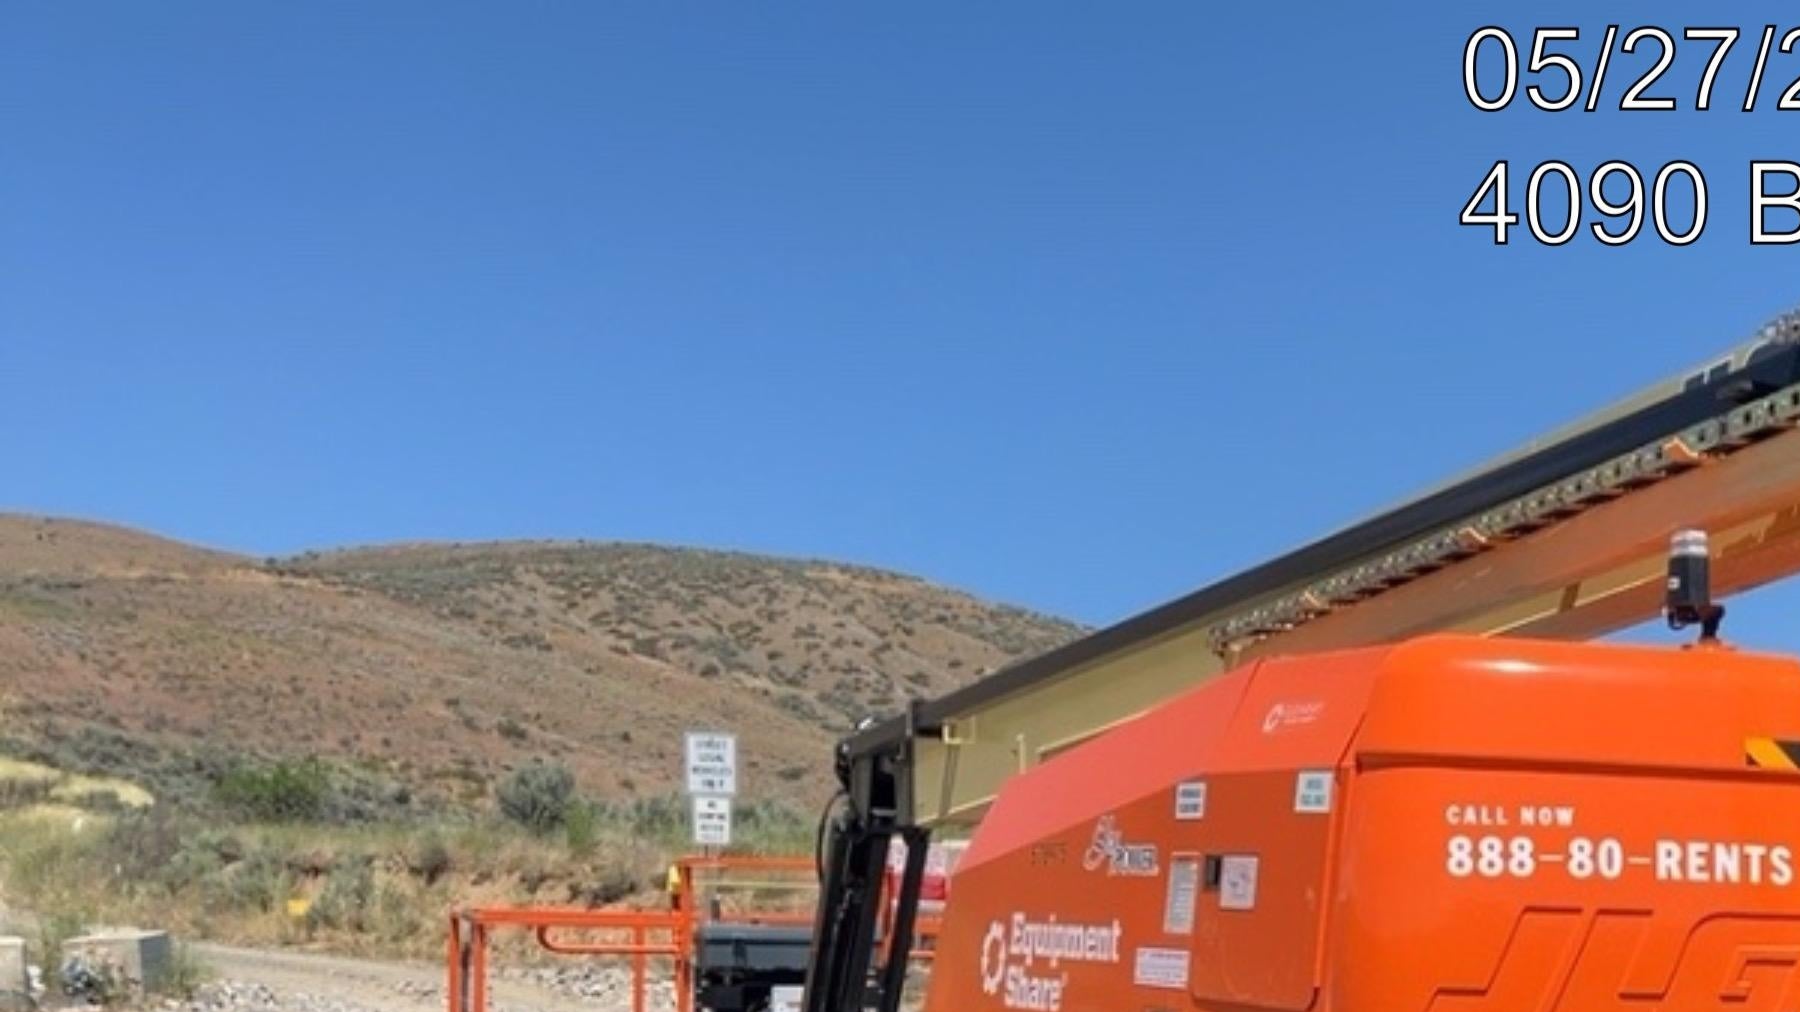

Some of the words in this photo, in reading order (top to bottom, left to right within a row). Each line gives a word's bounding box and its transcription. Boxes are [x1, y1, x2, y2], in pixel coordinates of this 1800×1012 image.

[1446, 804, 1508, 826] CALL
[1520, 805, 1575, 826] NOW
[1446, 835, 1794, 886] 888-80-RENTS
[1010, 911, 1122, 968] Equipment
